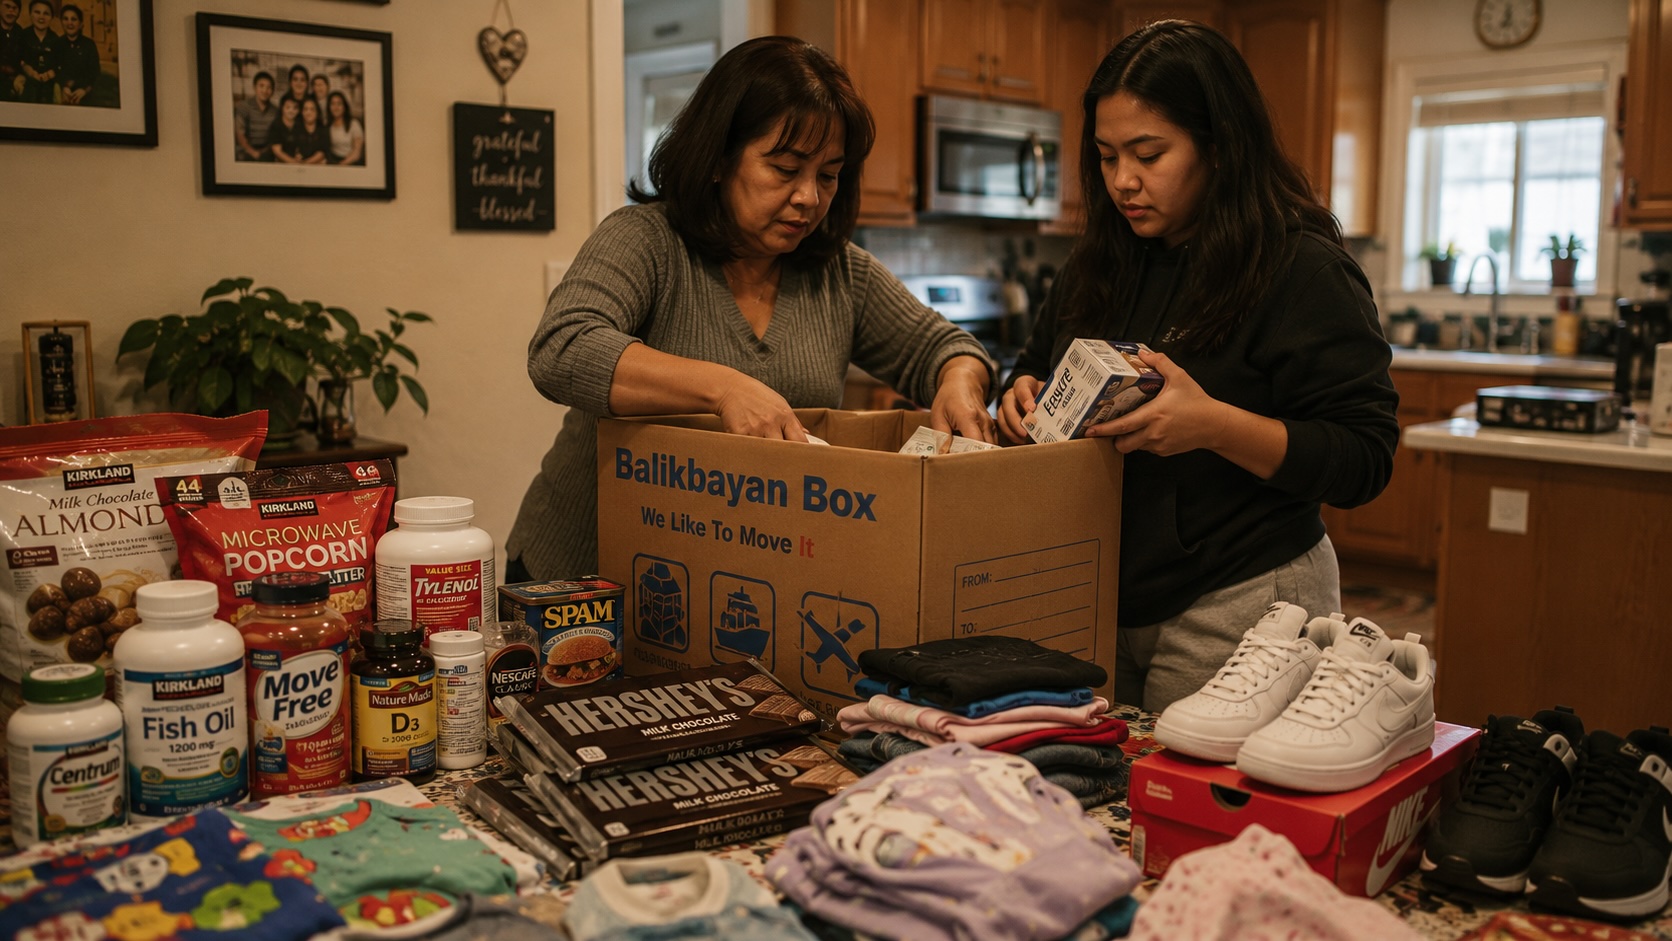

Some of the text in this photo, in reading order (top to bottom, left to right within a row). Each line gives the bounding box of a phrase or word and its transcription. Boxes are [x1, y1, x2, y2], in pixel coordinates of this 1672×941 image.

[472, 130, 541, 159] grateful
[472, 163, 542, 194] thankful
[480, 196, 536, 222] blessed
[66, 466, 131, 482] KIRKLAND
[176, 479, 200, 493] 44
[615, 447, 877, 522] Balikbayan Box
[48, 489, 154, 511] Milk Chocolate
[261, 501, 315, 514] KIRKLAND
[221, 518, 363, 549] MICROWAVE
[641, 506, 814, 558] We Like To Move It
[224, 536, 368, 577] POPCORN
[414, 573, 479, 597] TYLENOL
[962, 572, 992, 588] FROM:
[544, 599, 616, 629] SPAM
[960, 622, 977, 635] TO:
[155, 675, 222, 693] KIRKLAND
[263, 660, 339, 700] Move
[273, 687, 333, 721] Free
[372, 694, 407, 706] Nature
[543, 677, 757, 737] HERSHEY'S
[143, 707, 235, 741] Fish Oil
[391, 712, 420, 734] D3
[641, 724, 670, 737] MILK
[671, 712, 741, 731] CHOCOLATE
[169, 742, 197, 753] 1200
[50, 756, 120, 785] Centrum
[576, 748, 799, 812] HERSHEY'S
[673, 783, 781, 810] MILK CHOCOLATE
